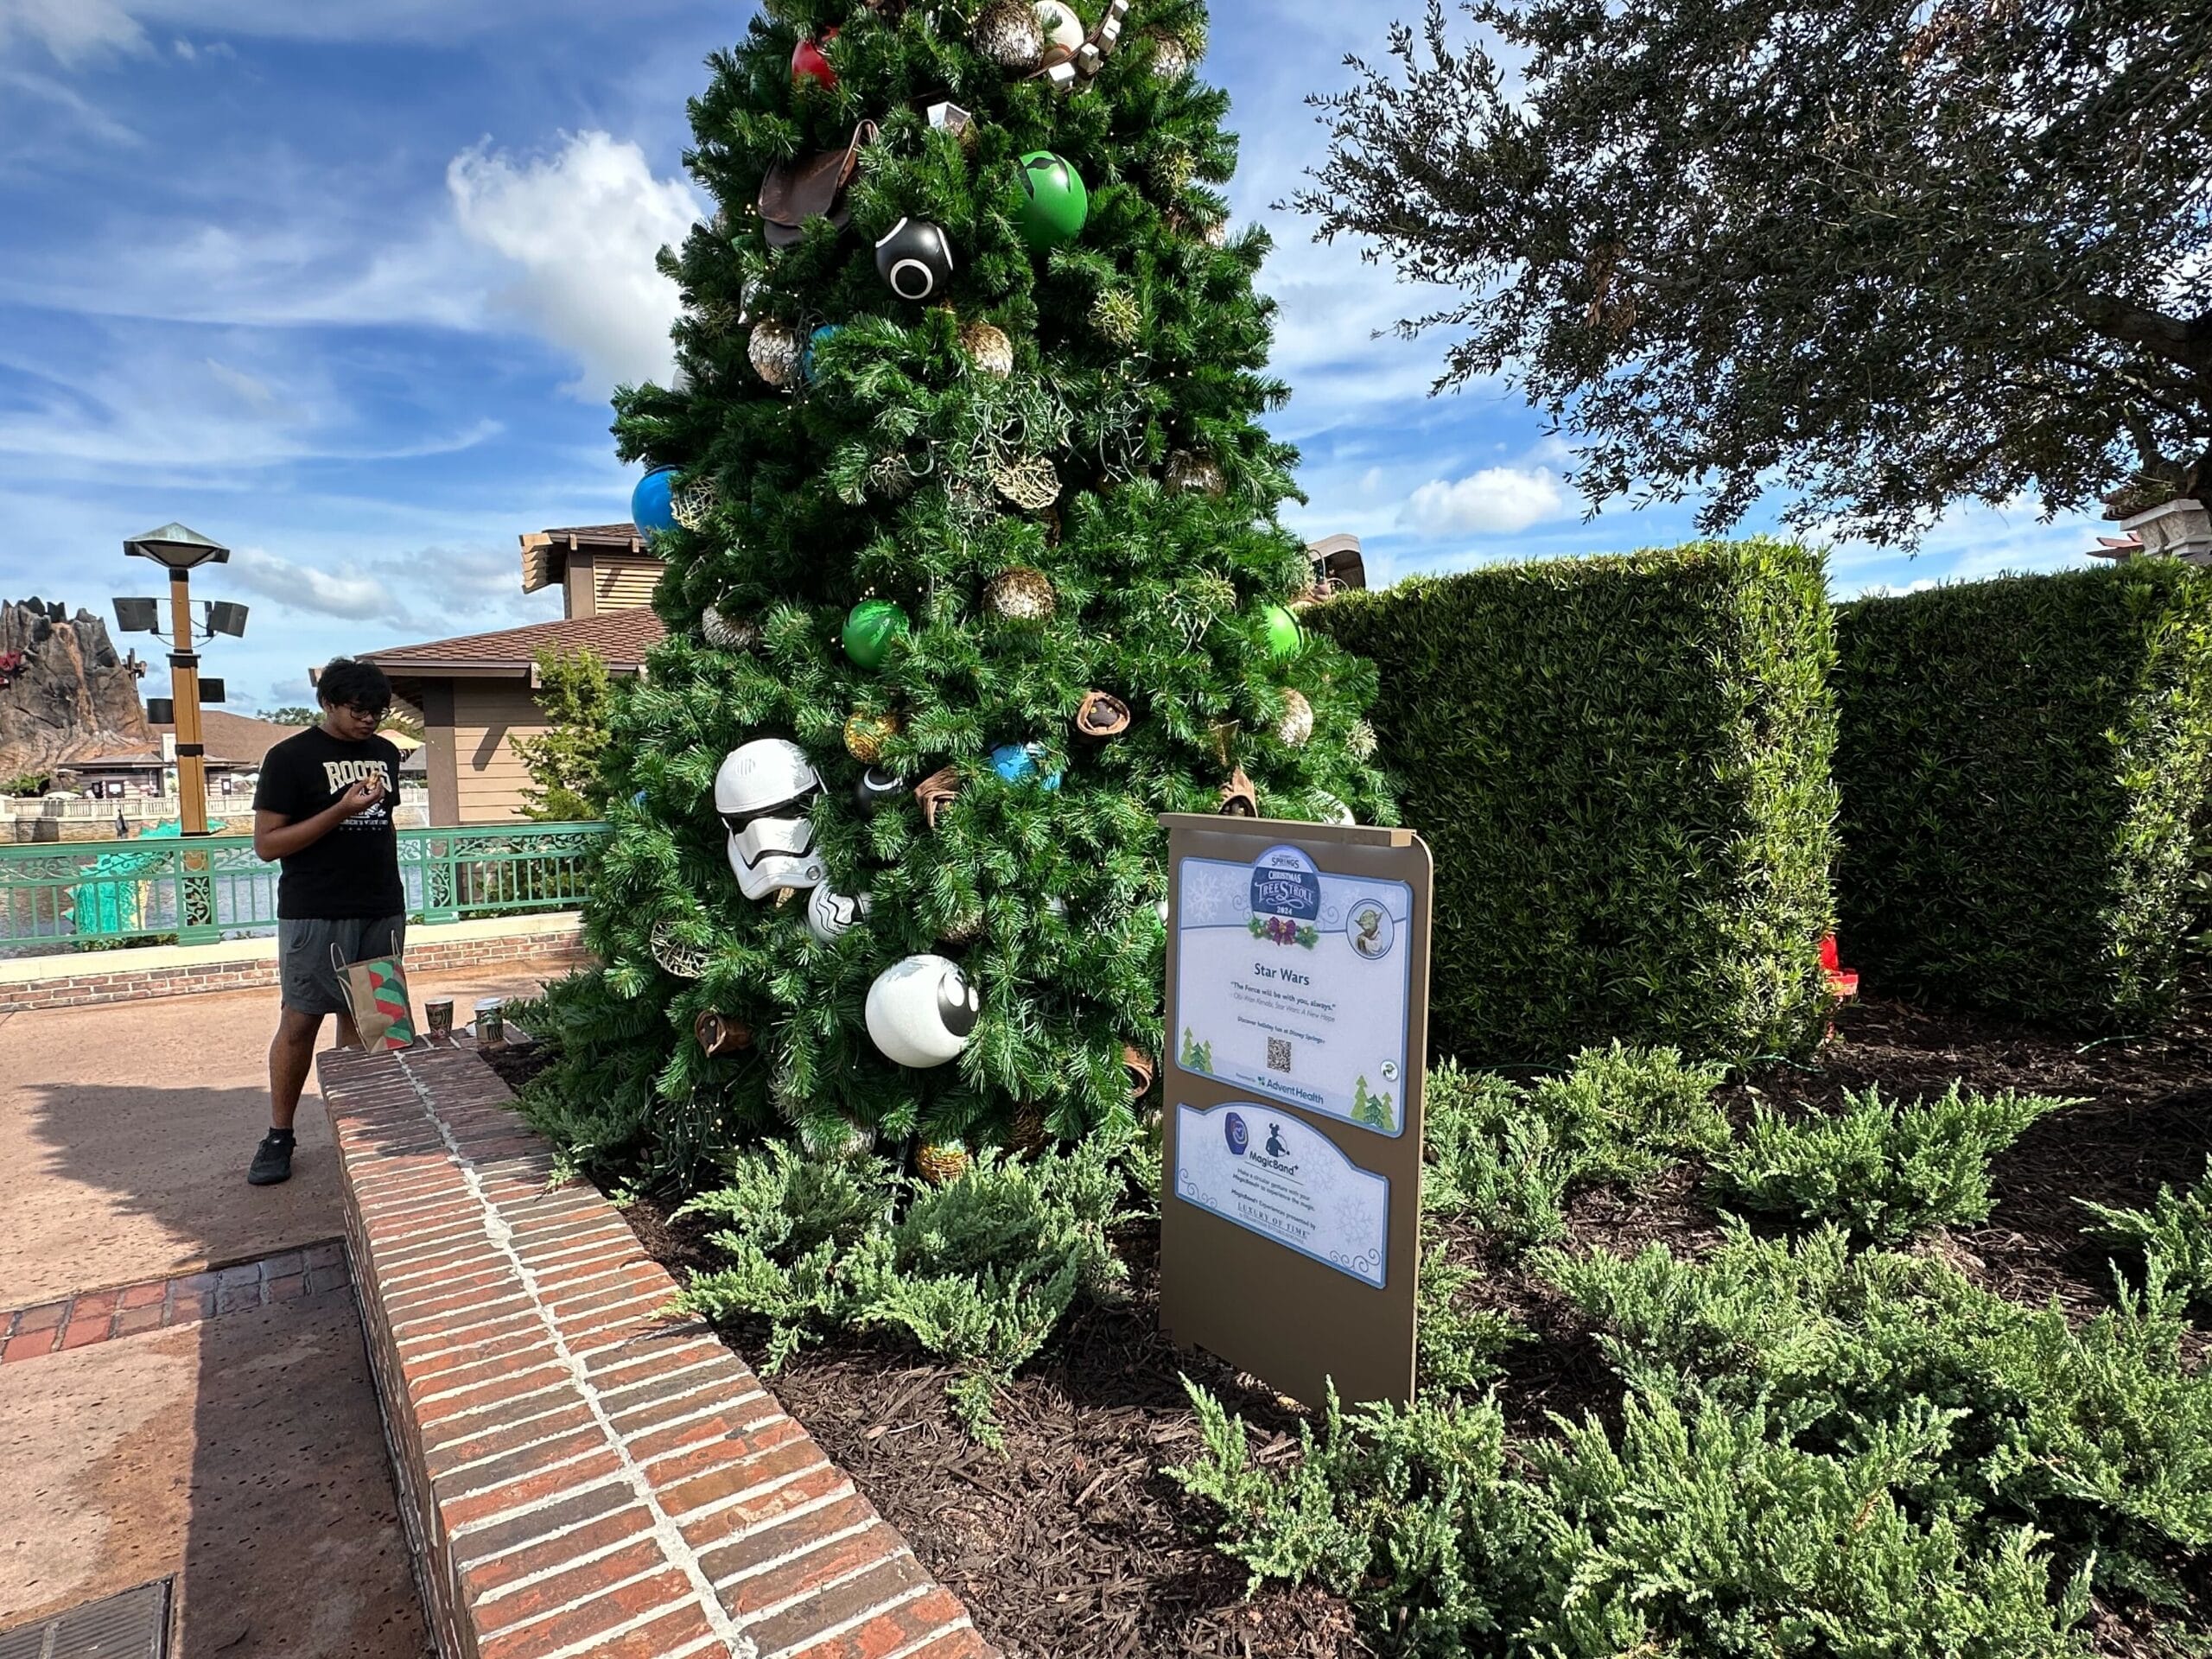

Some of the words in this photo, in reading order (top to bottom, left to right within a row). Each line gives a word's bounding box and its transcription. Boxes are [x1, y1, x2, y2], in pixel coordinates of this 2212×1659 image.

[322, 760, 392, 795] ROOTS
[1271, 856, 1300, 869] SPRINGS
[1268, 870, 1301, 883] CHRISTMAS
[1254, 963, 1277, 979] Star
[1280, 968, 1310, 986] Wars
[1244, 984, 1261, 995] Force
[1262, 988, 1273, 997] will
[1273, 989, 1281, 999] be
[1282, 993, 1295, 1002] with
[1319, 1014, 1336, 1023] Hope
[1237, 1201, 1268, 1223] LUXURY
[1272, 1217, 1284, 1228] OF
